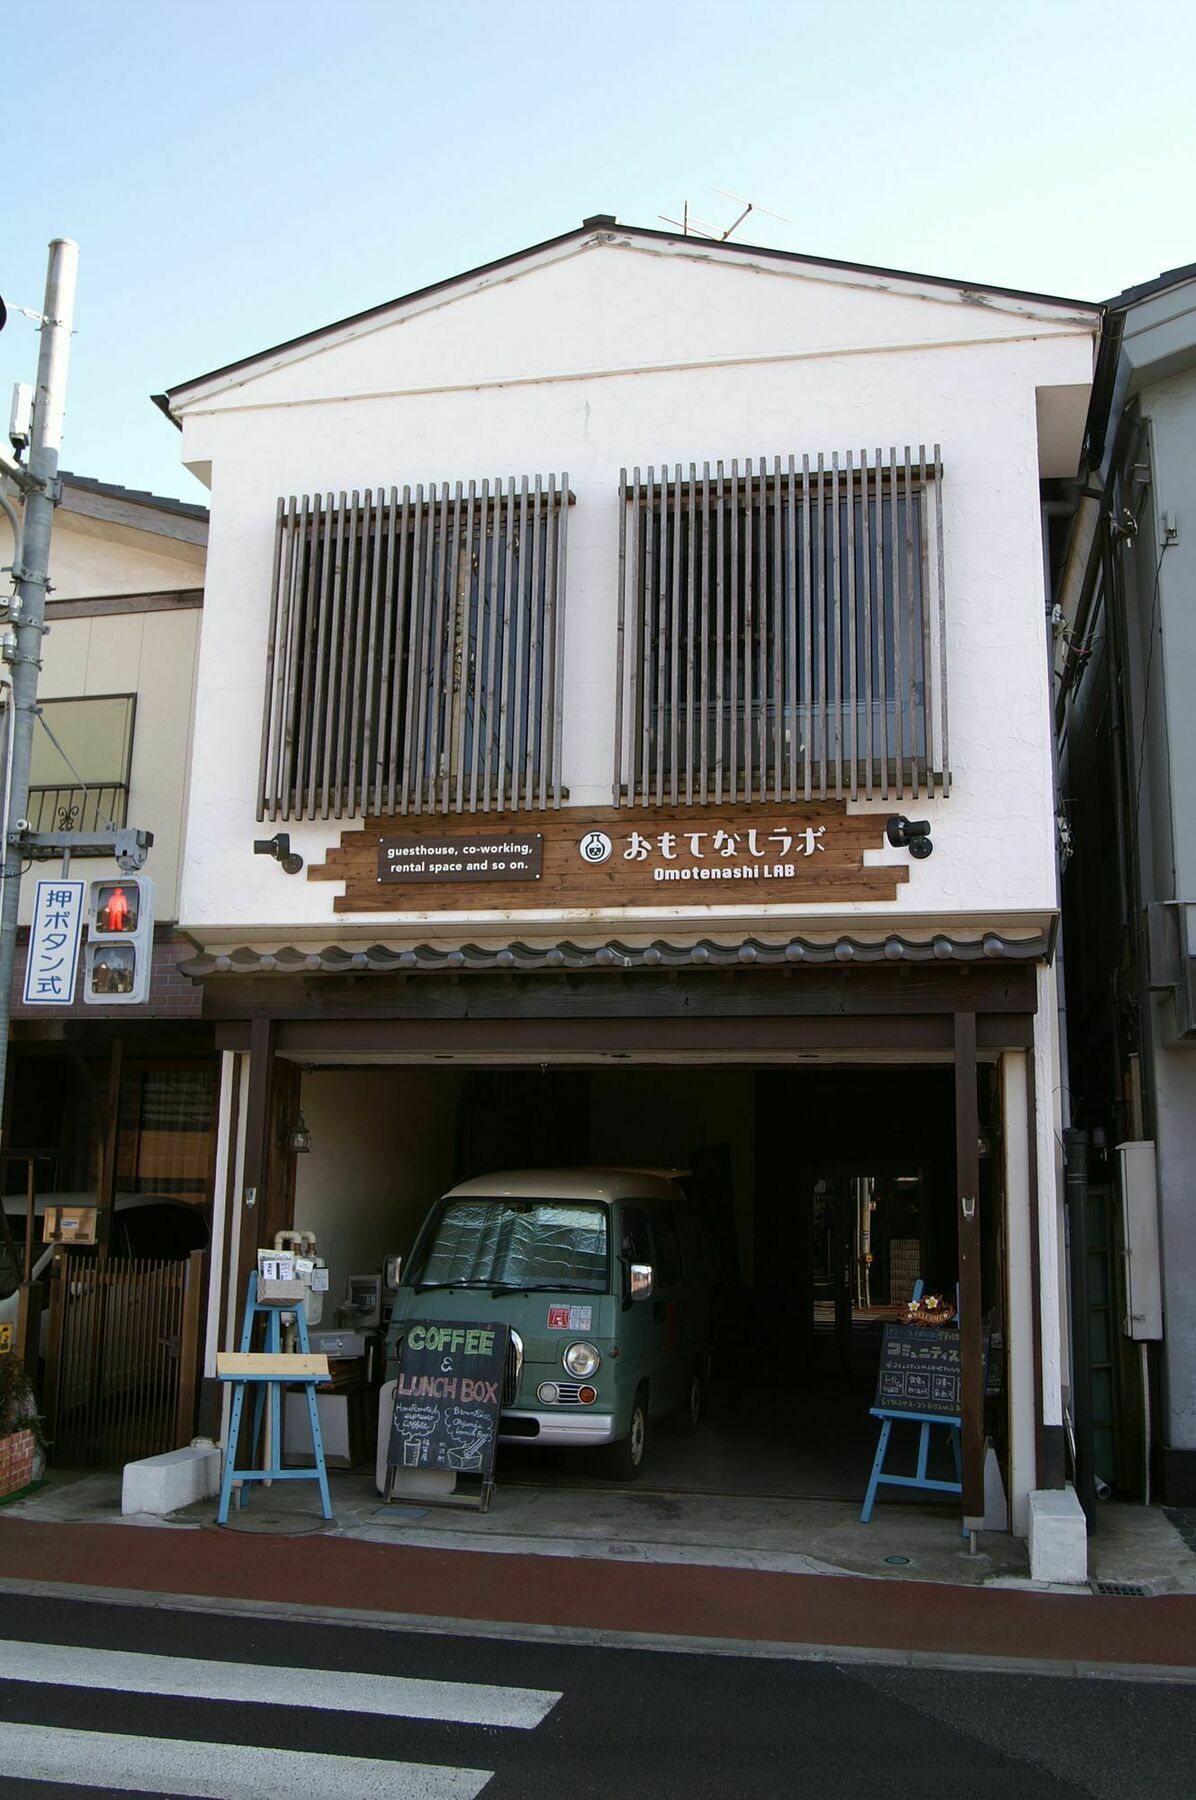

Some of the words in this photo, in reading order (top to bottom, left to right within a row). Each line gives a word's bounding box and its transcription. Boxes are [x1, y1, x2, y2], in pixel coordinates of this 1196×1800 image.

[387, 845, 459, 859] guesthouse,
[462, 842, 533, 855] co-working,
[623, 825, 827, 861] おもてなしラボ
[390, 861, 425, 872] rental
[429, 862, 463, 874] space
[466, 860, 488, 871] and
[491, 861, 506, 870] so
[509, 861, 529, 869] on.
[653, 864, 759, 881] Omotenashi
[763, 863, 796, 879] LAB
[36, 889, 73, 995] 押ボタン式
[911, 1310, 943, 1323] WELCOME
[407, 1325, 496, 1356] COFFEE
[440, 1356, 454, 1373] &
[397, 1373, 458, 1400] LUNCH
[460, 1377, 499, 1404] BOX
